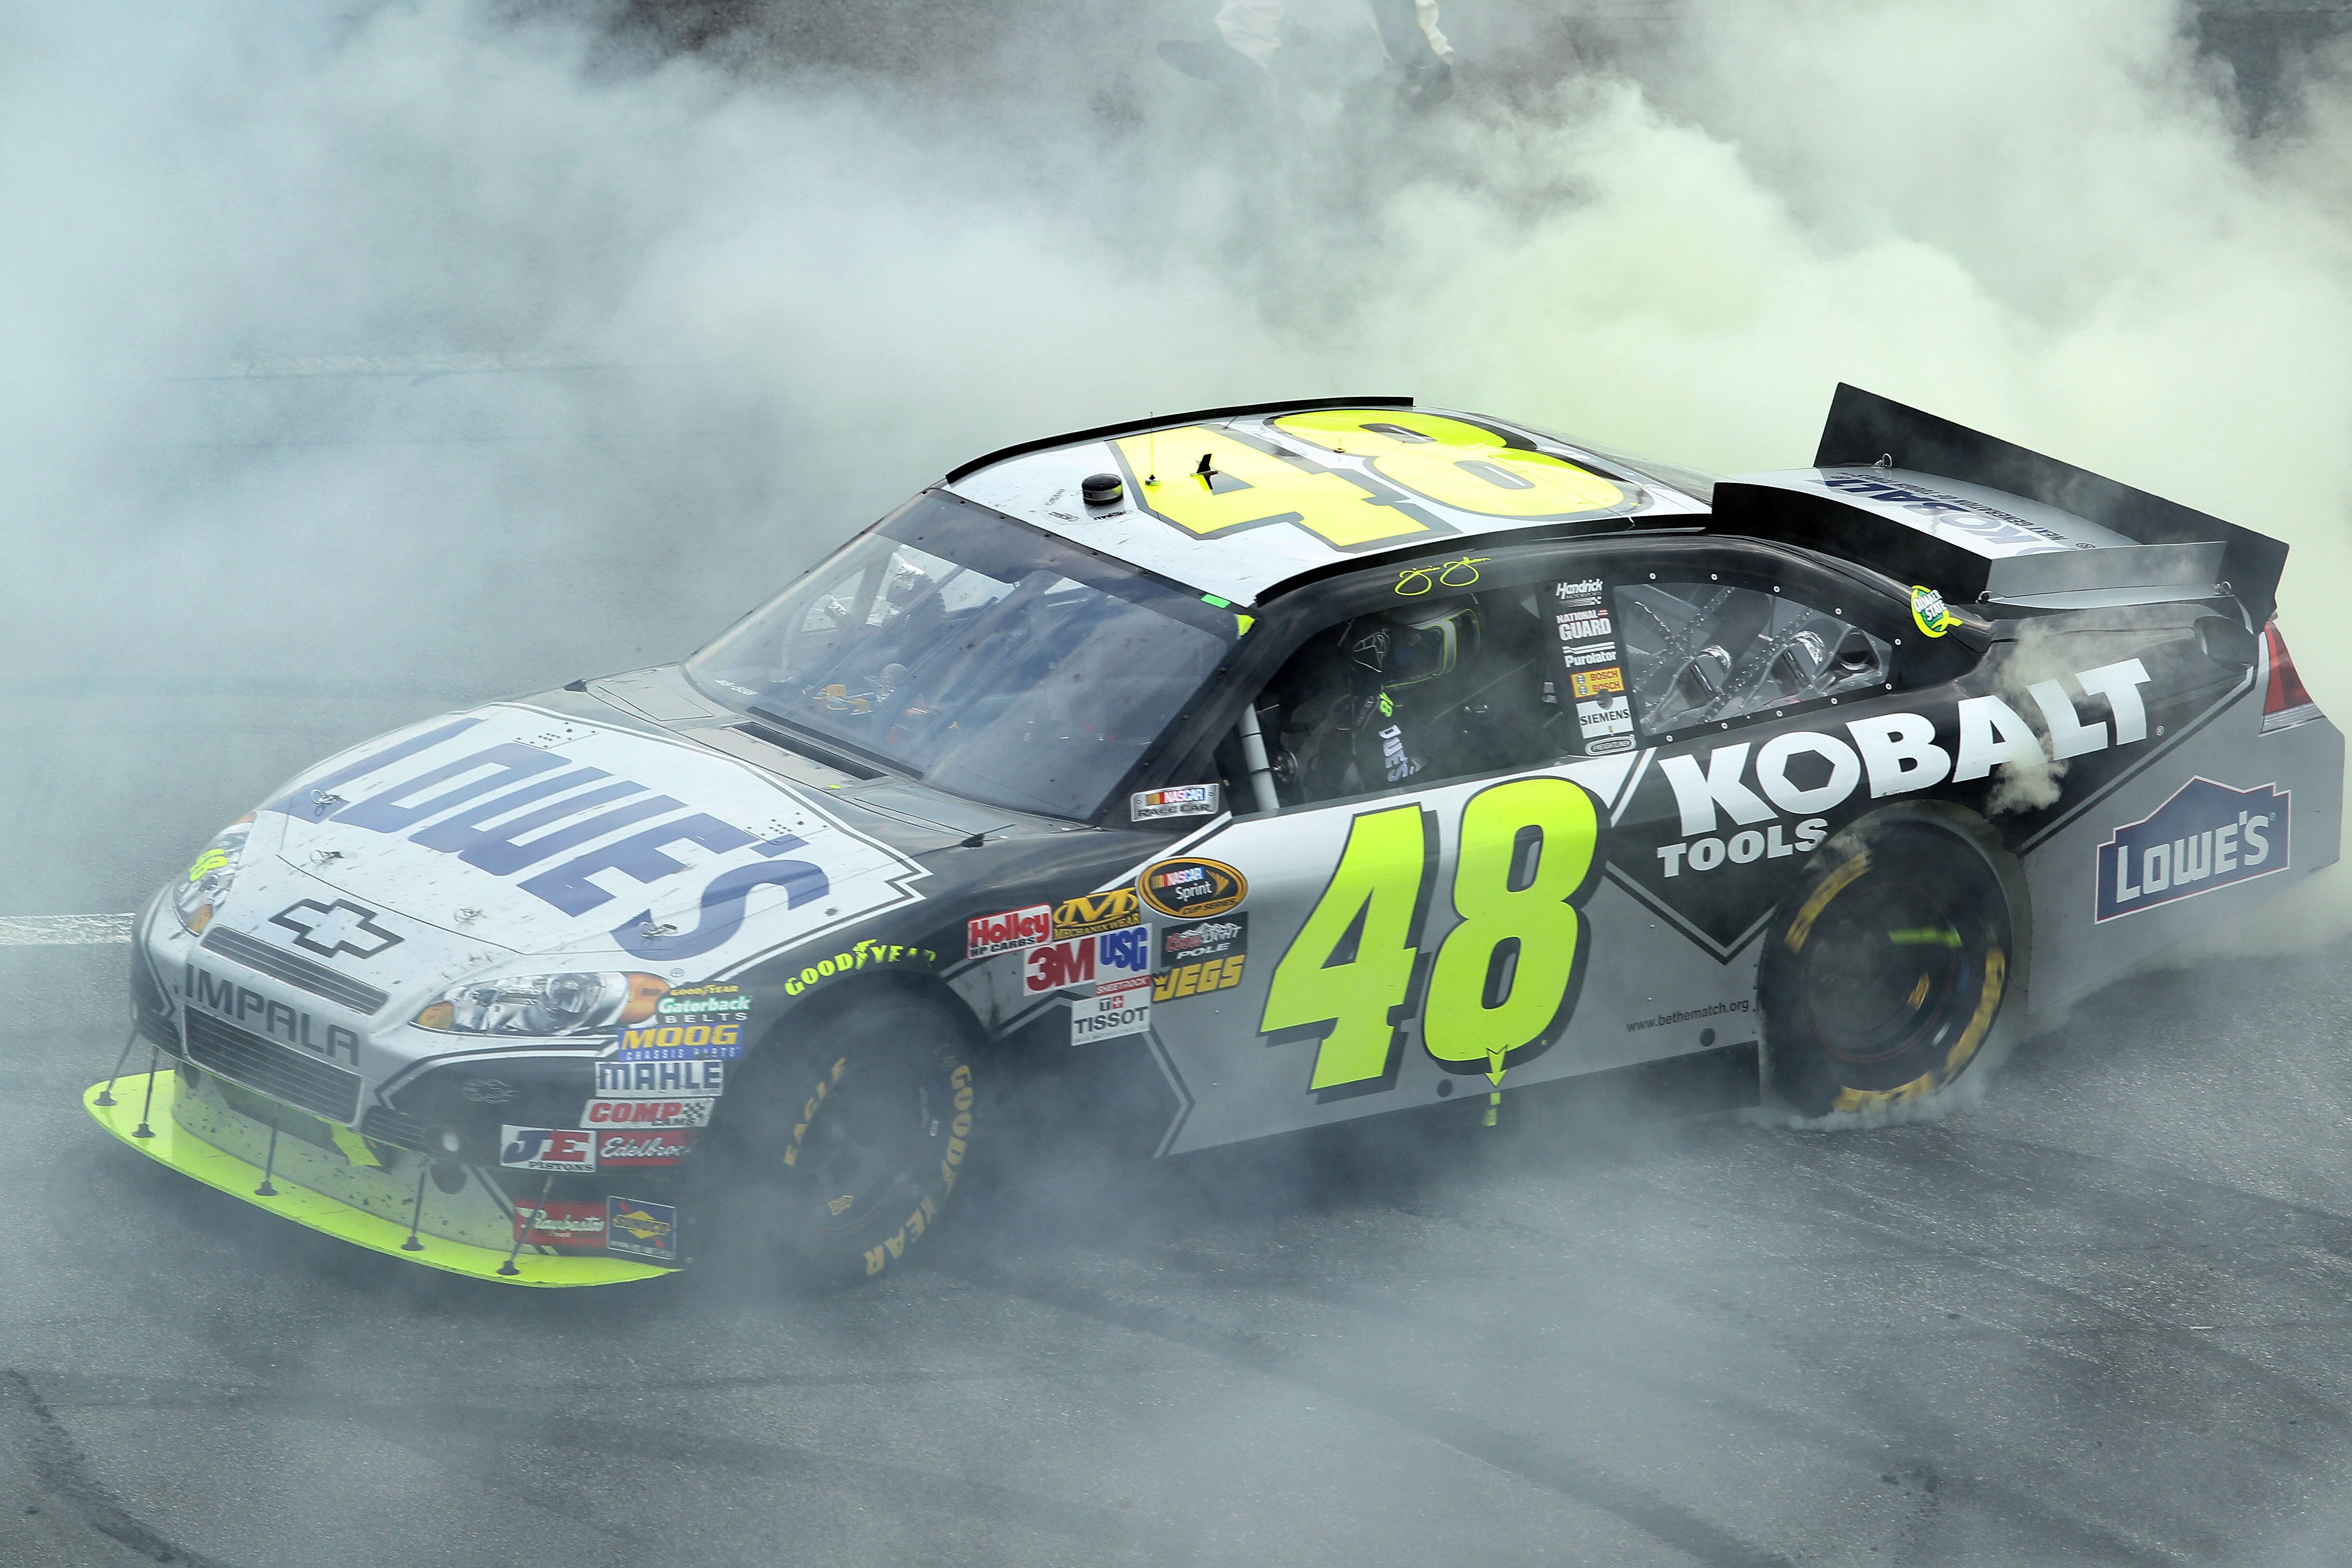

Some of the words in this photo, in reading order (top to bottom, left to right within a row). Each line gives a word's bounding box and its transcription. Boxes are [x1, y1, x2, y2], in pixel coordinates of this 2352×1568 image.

[1115, 409, 1625, 547] 48
[1803, 479, 2042, 544] KOBALT
[1556, 578, 1604, 599] Hendrick
[1913, 589, 1943, 613] QUAKER
[1925, 600, 1948, 621] STATE
[1556, 610, 1598, 624] NATIONAL
[1558, 618, 1612, 641] GUARD
[1564, 651, 1617, 668] Purolator
[1590, 671, 1618, 682] BOSCH
[1592, 681, 1620, 692] BOSCH
[1580, 709, 1630, 726] SIEMENS
[1657, 658, 2152, 837] KOBALT
[1164, 787, 1205, 804] NASCAR
[1139, 808, 1177, 817] RACE
[1180, 804, 1210, 813] CAR
[264, 717, 830, 961] LOWE'S
[1656, 818, 1829, 878] TOOLS
[2116, 810, 2269, 904] LOWE'S
[1166, 867, 1204, 886] NASCAR
[1175, 881, 1213, 902] Sprint
[971, 912, 1050, 946] Holley
[1260, 778, 1598, 1090] 48
[969, 945, 987, 957] HP
[991, 937, 1035, 953] CARBS
[1101, 926, 1147, 972] USG
[1176, 942, 1231, 960] POLE
[1026, 937, 1095, 992] 3M
[1152, 954, 1246, 1002] JEGS
[185, 963, 359, 1067] IMPALA
[657, 995, 752, 1014] Gatorback
[1626, 999, 1749, 1032] www.bethematch.org
[664, 1012, 748, 1024] BELTS
[1075, 1005, 1149, 1034] TISSOT
[620, 1024, 740, 1050] MOOG
[625, 1048, 685, 1061] CHASSIS
[600, 1062, 722, 1090] MAHLE
[588, 1102, 683, 1123] COMP
[503, 1130, 590, 1164] JE
[600, 1136, 698, 1159] Edelbroc
[529, 1160, 593, 1172] PISTONS
